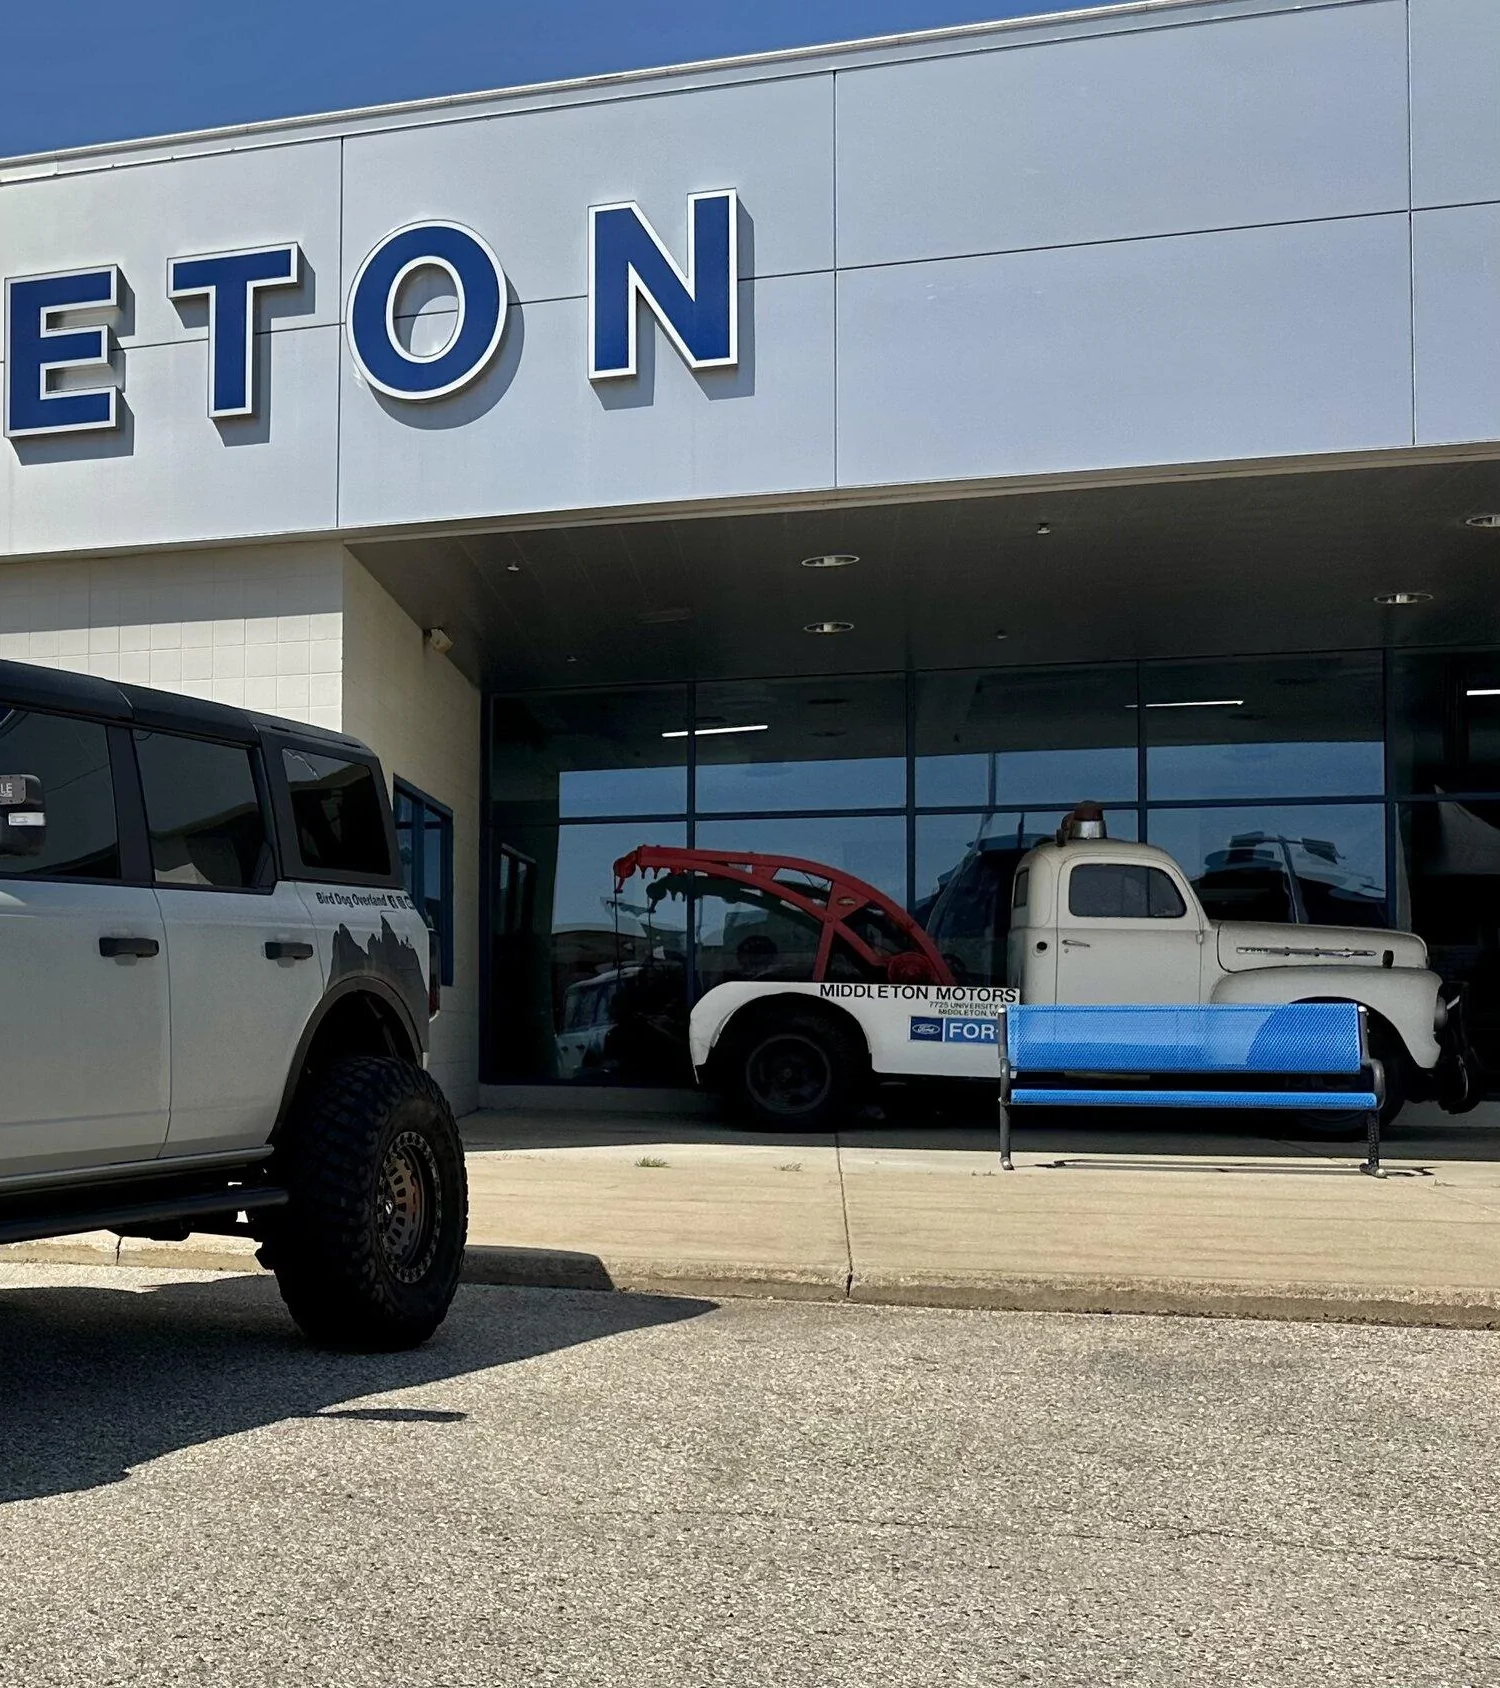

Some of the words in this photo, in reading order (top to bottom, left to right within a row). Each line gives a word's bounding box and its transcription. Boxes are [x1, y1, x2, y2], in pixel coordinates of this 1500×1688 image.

[316, 892, 335, 904] Bird
[334, 893, 354, 908] Dog
[352, 893, 388, 907] Overland
[820, 984, 929, 1000] MIDDLETON
[936, 987, 1017, 1003] MOTORS
[950, 1002, 999, 1010] UNIVERSITY
